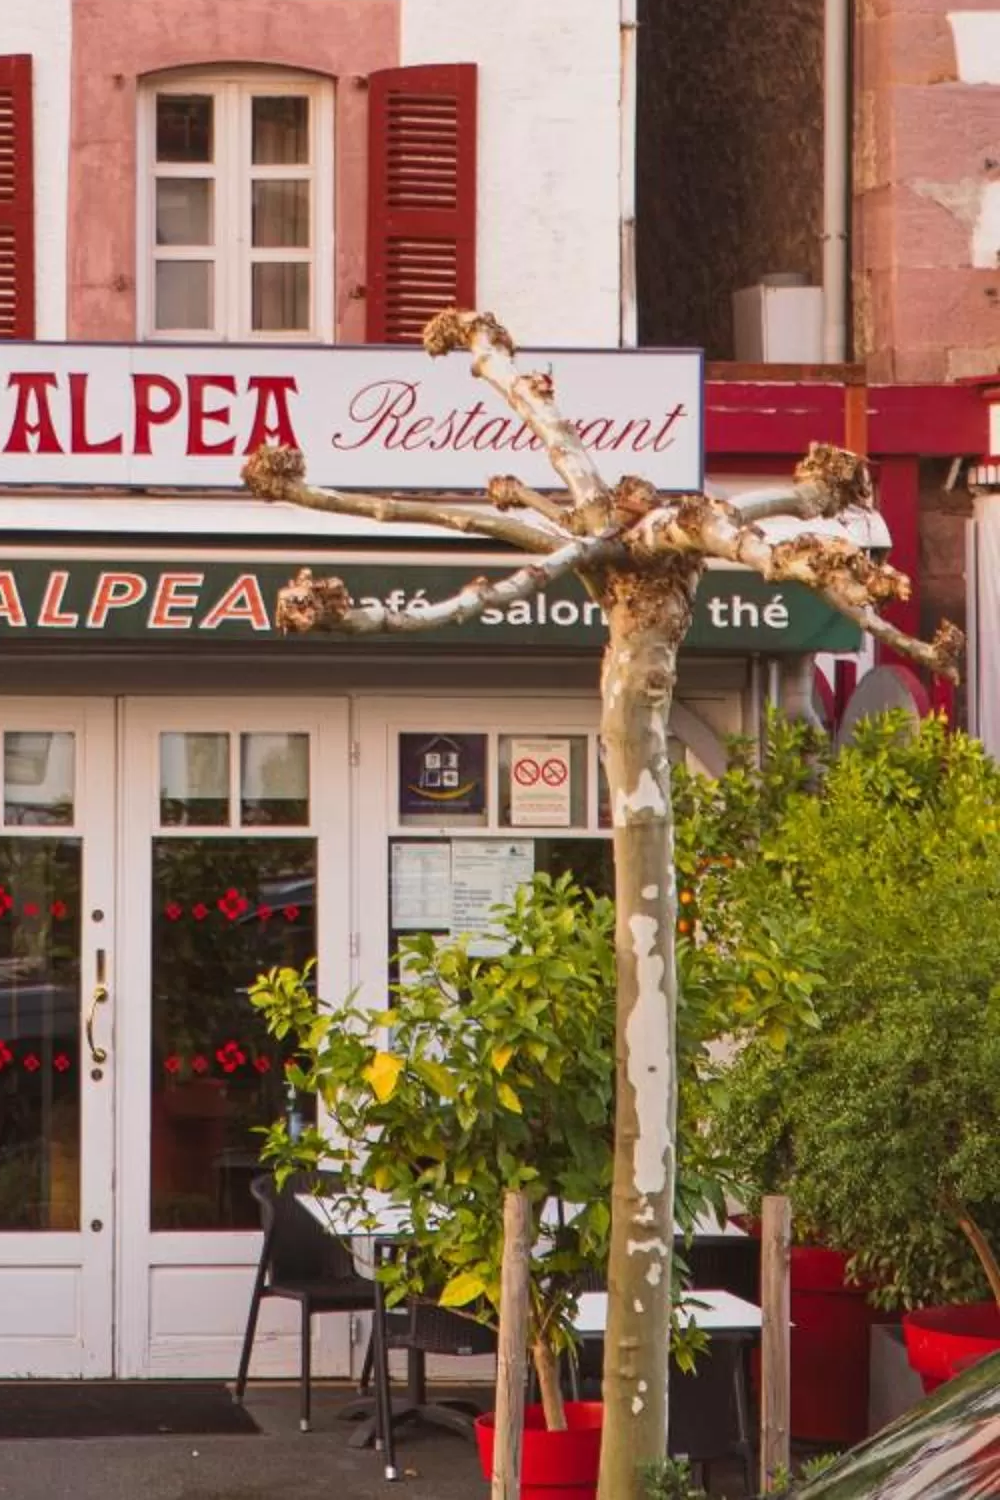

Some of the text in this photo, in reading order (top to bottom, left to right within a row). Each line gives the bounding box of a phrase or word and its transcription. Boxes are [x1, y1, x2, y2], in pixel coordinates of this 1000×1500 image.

[331, 380, 688, 452] Restauant
[345, 588, 428, 617] afé
[480, 592, 608, 626] salon
[707, 595, 789, 628] thé
